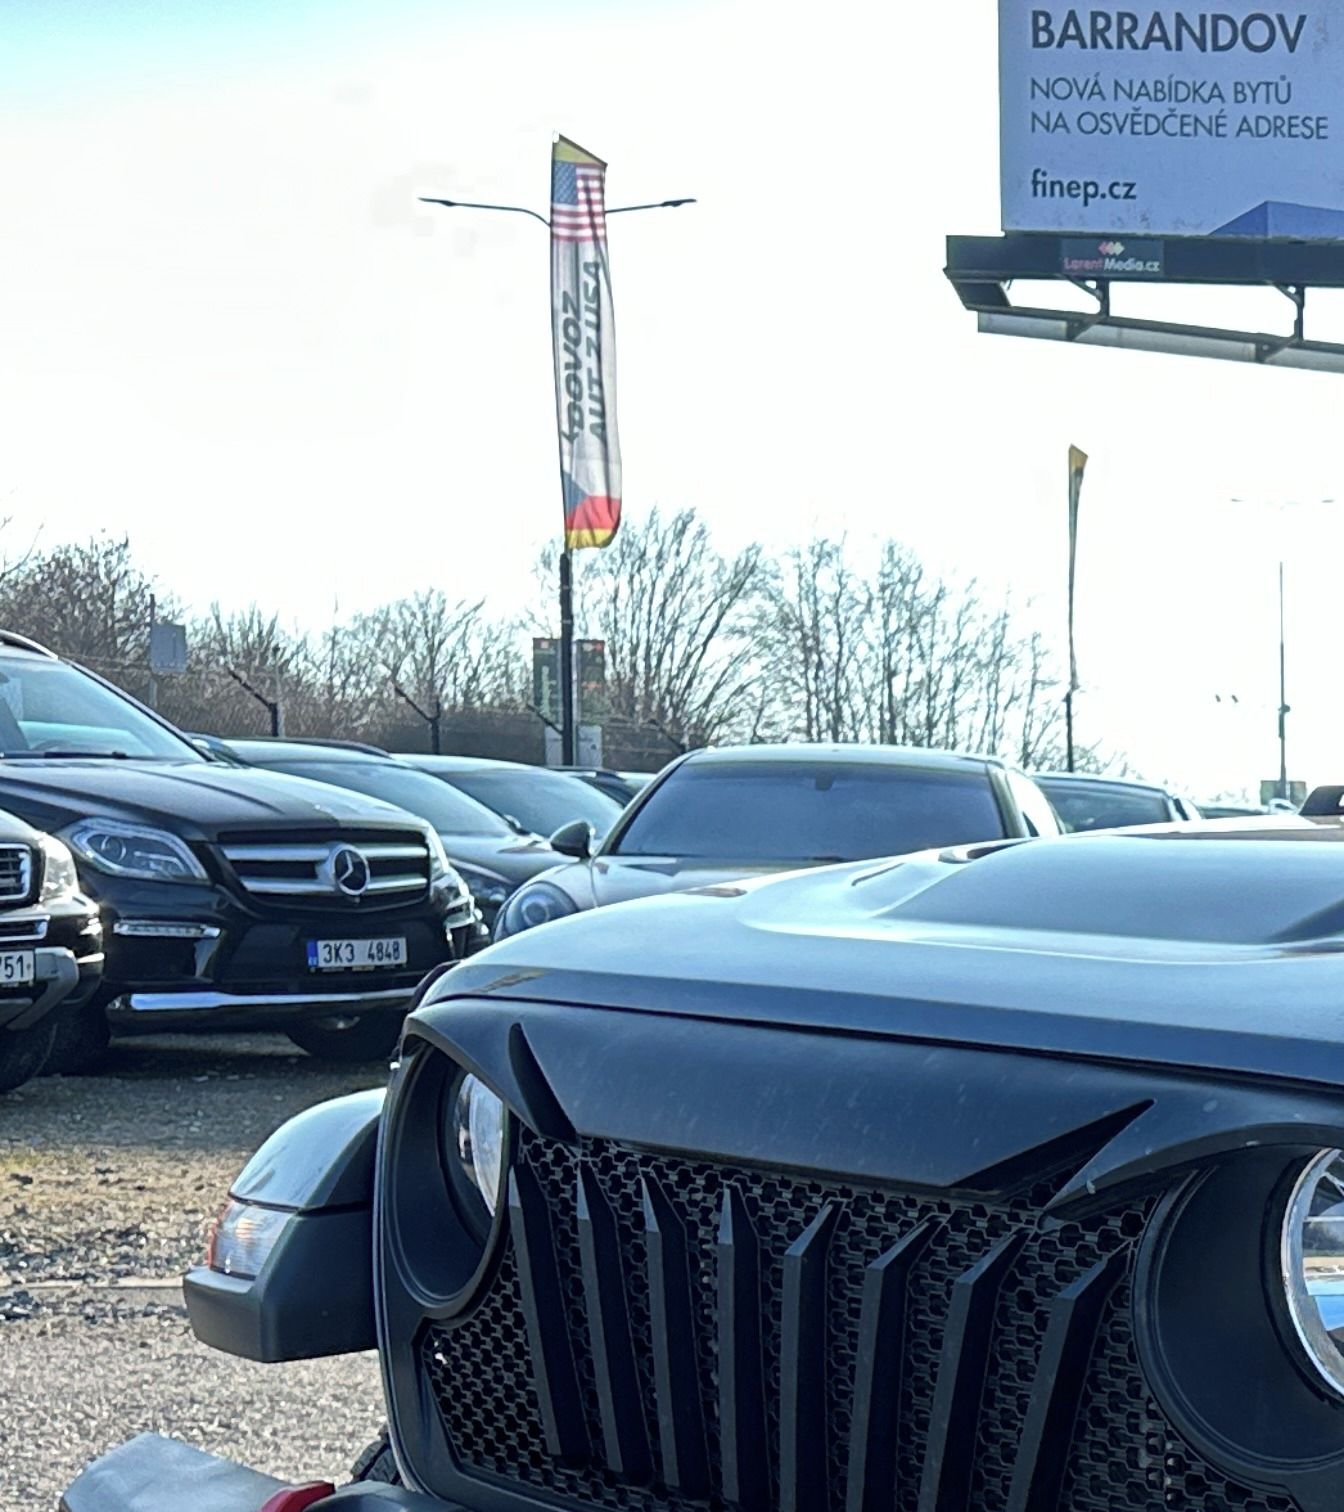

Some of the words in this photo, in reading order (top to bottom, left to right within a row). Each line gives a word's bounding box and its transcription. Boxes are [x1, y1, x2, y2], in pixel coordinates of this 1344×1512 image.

[1031, 10, 1307, 54] BARRANDOV
[1030, 73, 1105, 101] NOVÁ
[1113, 75, 1224, 104] NABÍDKA
[1233, 75, 1292, 105] BYTŮ
[1031, 111, 1070, 134] NA
[1077, 108, 1228, 139] OSVĚDČENÉ
[1236, 117, 1328, 140] ADRESE
[1032, 168, 1136, 206] finep.cz
[321, 943, 355, 963] 3K3
